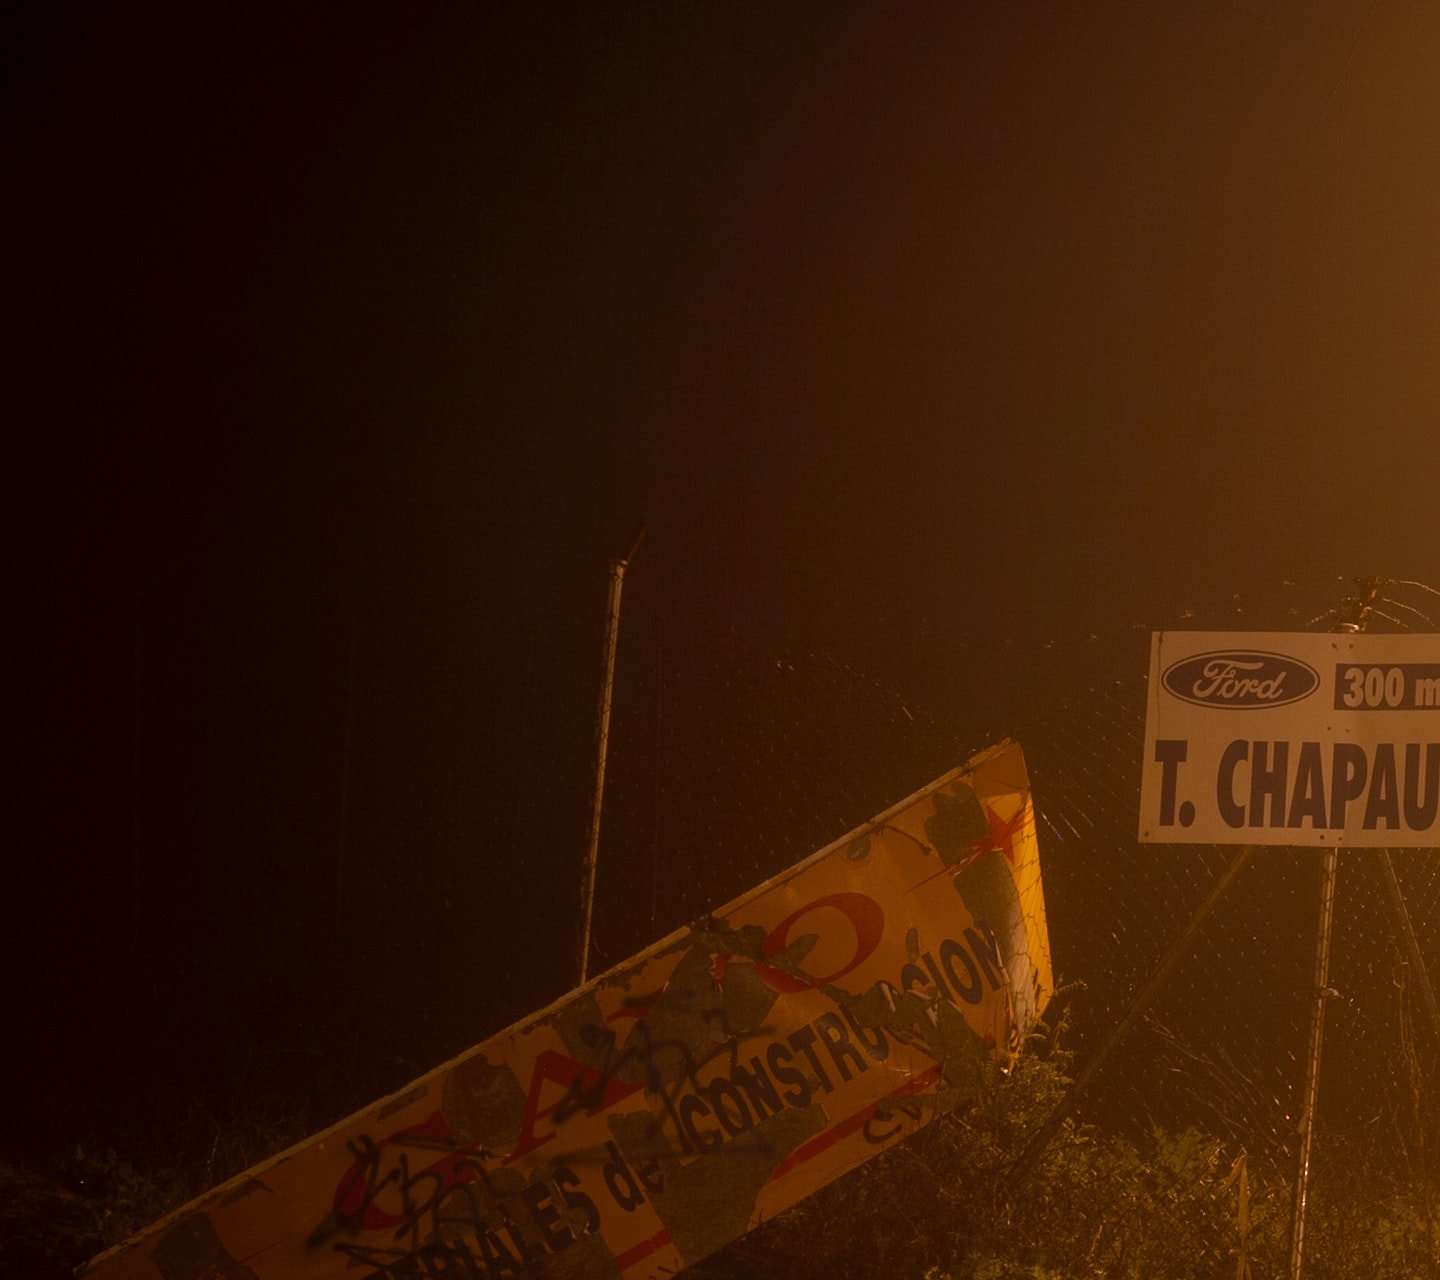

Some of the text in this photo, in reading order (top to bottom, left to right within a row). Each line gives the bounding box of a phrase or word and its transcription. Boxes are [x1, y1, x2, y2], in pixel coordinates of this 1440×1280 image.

[1192, 659, 1284, 701] Ford
[1343, 667, 1405, 707] 300
[1155, 739, 1195, 827] T.
[603, 1141, 665, 1213] de
